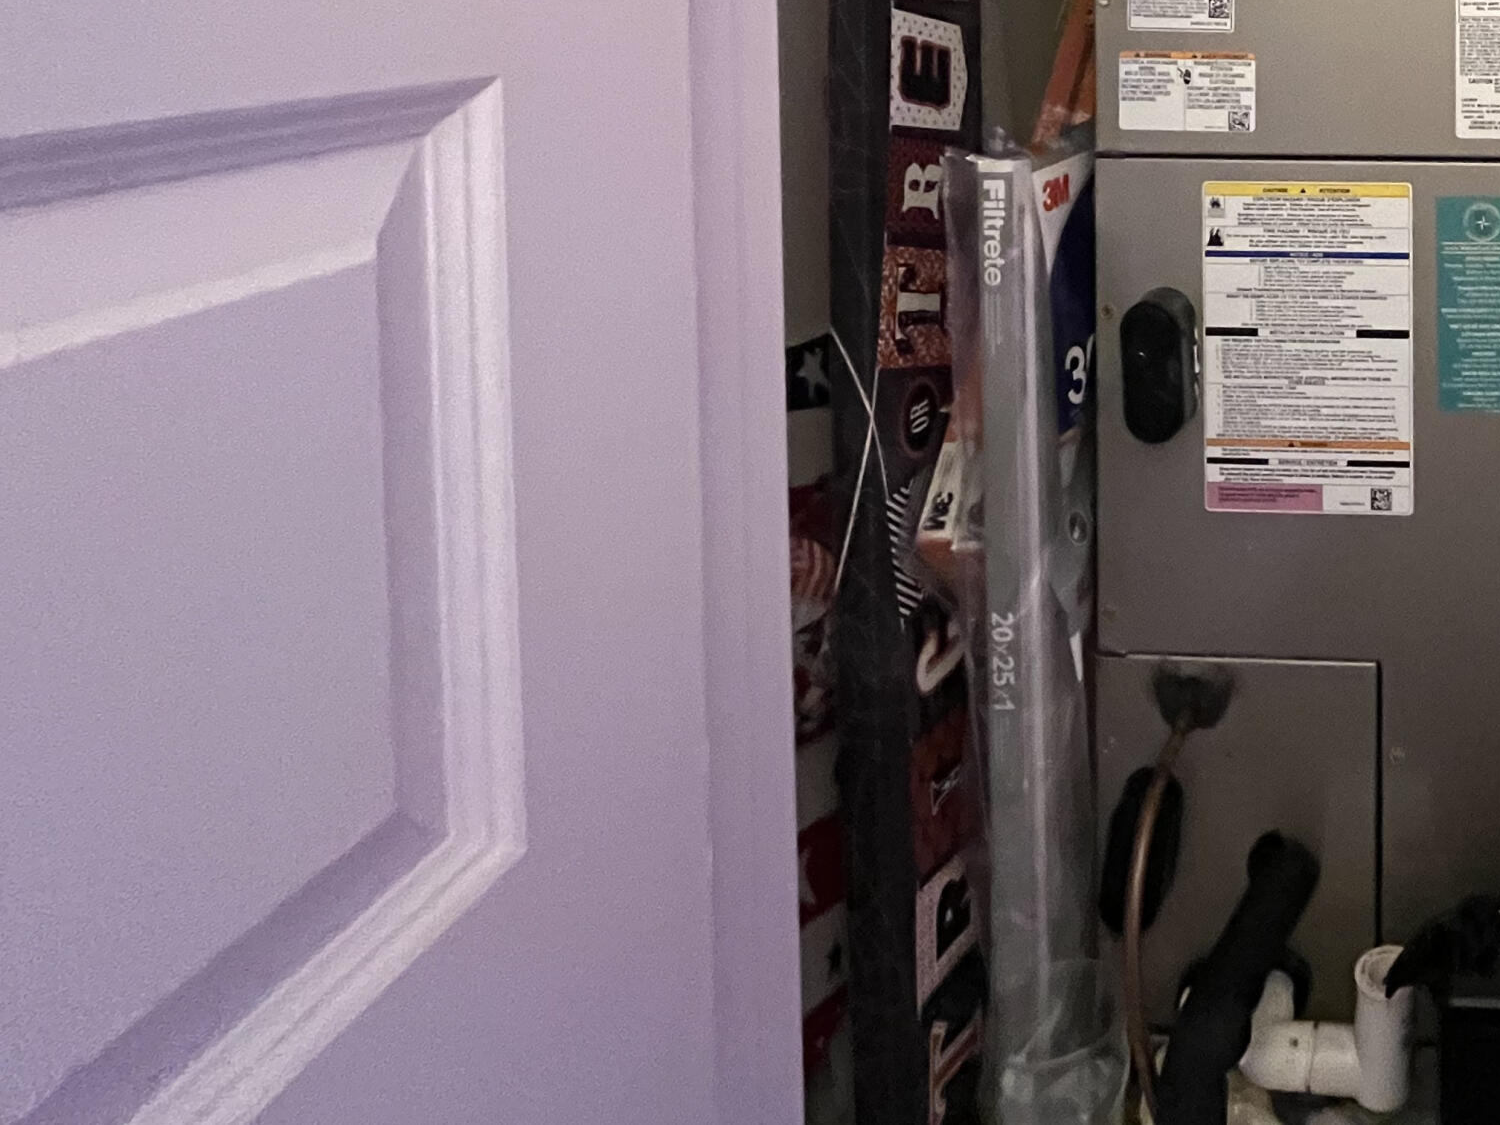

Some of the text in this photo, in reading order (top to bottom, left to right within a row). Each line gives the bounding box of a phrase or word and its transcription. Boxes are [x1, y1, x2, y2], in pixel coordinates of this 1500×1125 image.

[1041, 173, 1071, 214] 3M
[982, 177, 1007, 288] Filtrete
[907, 399, 932, 435] OR
[922, 490, 954, 533] 3M
